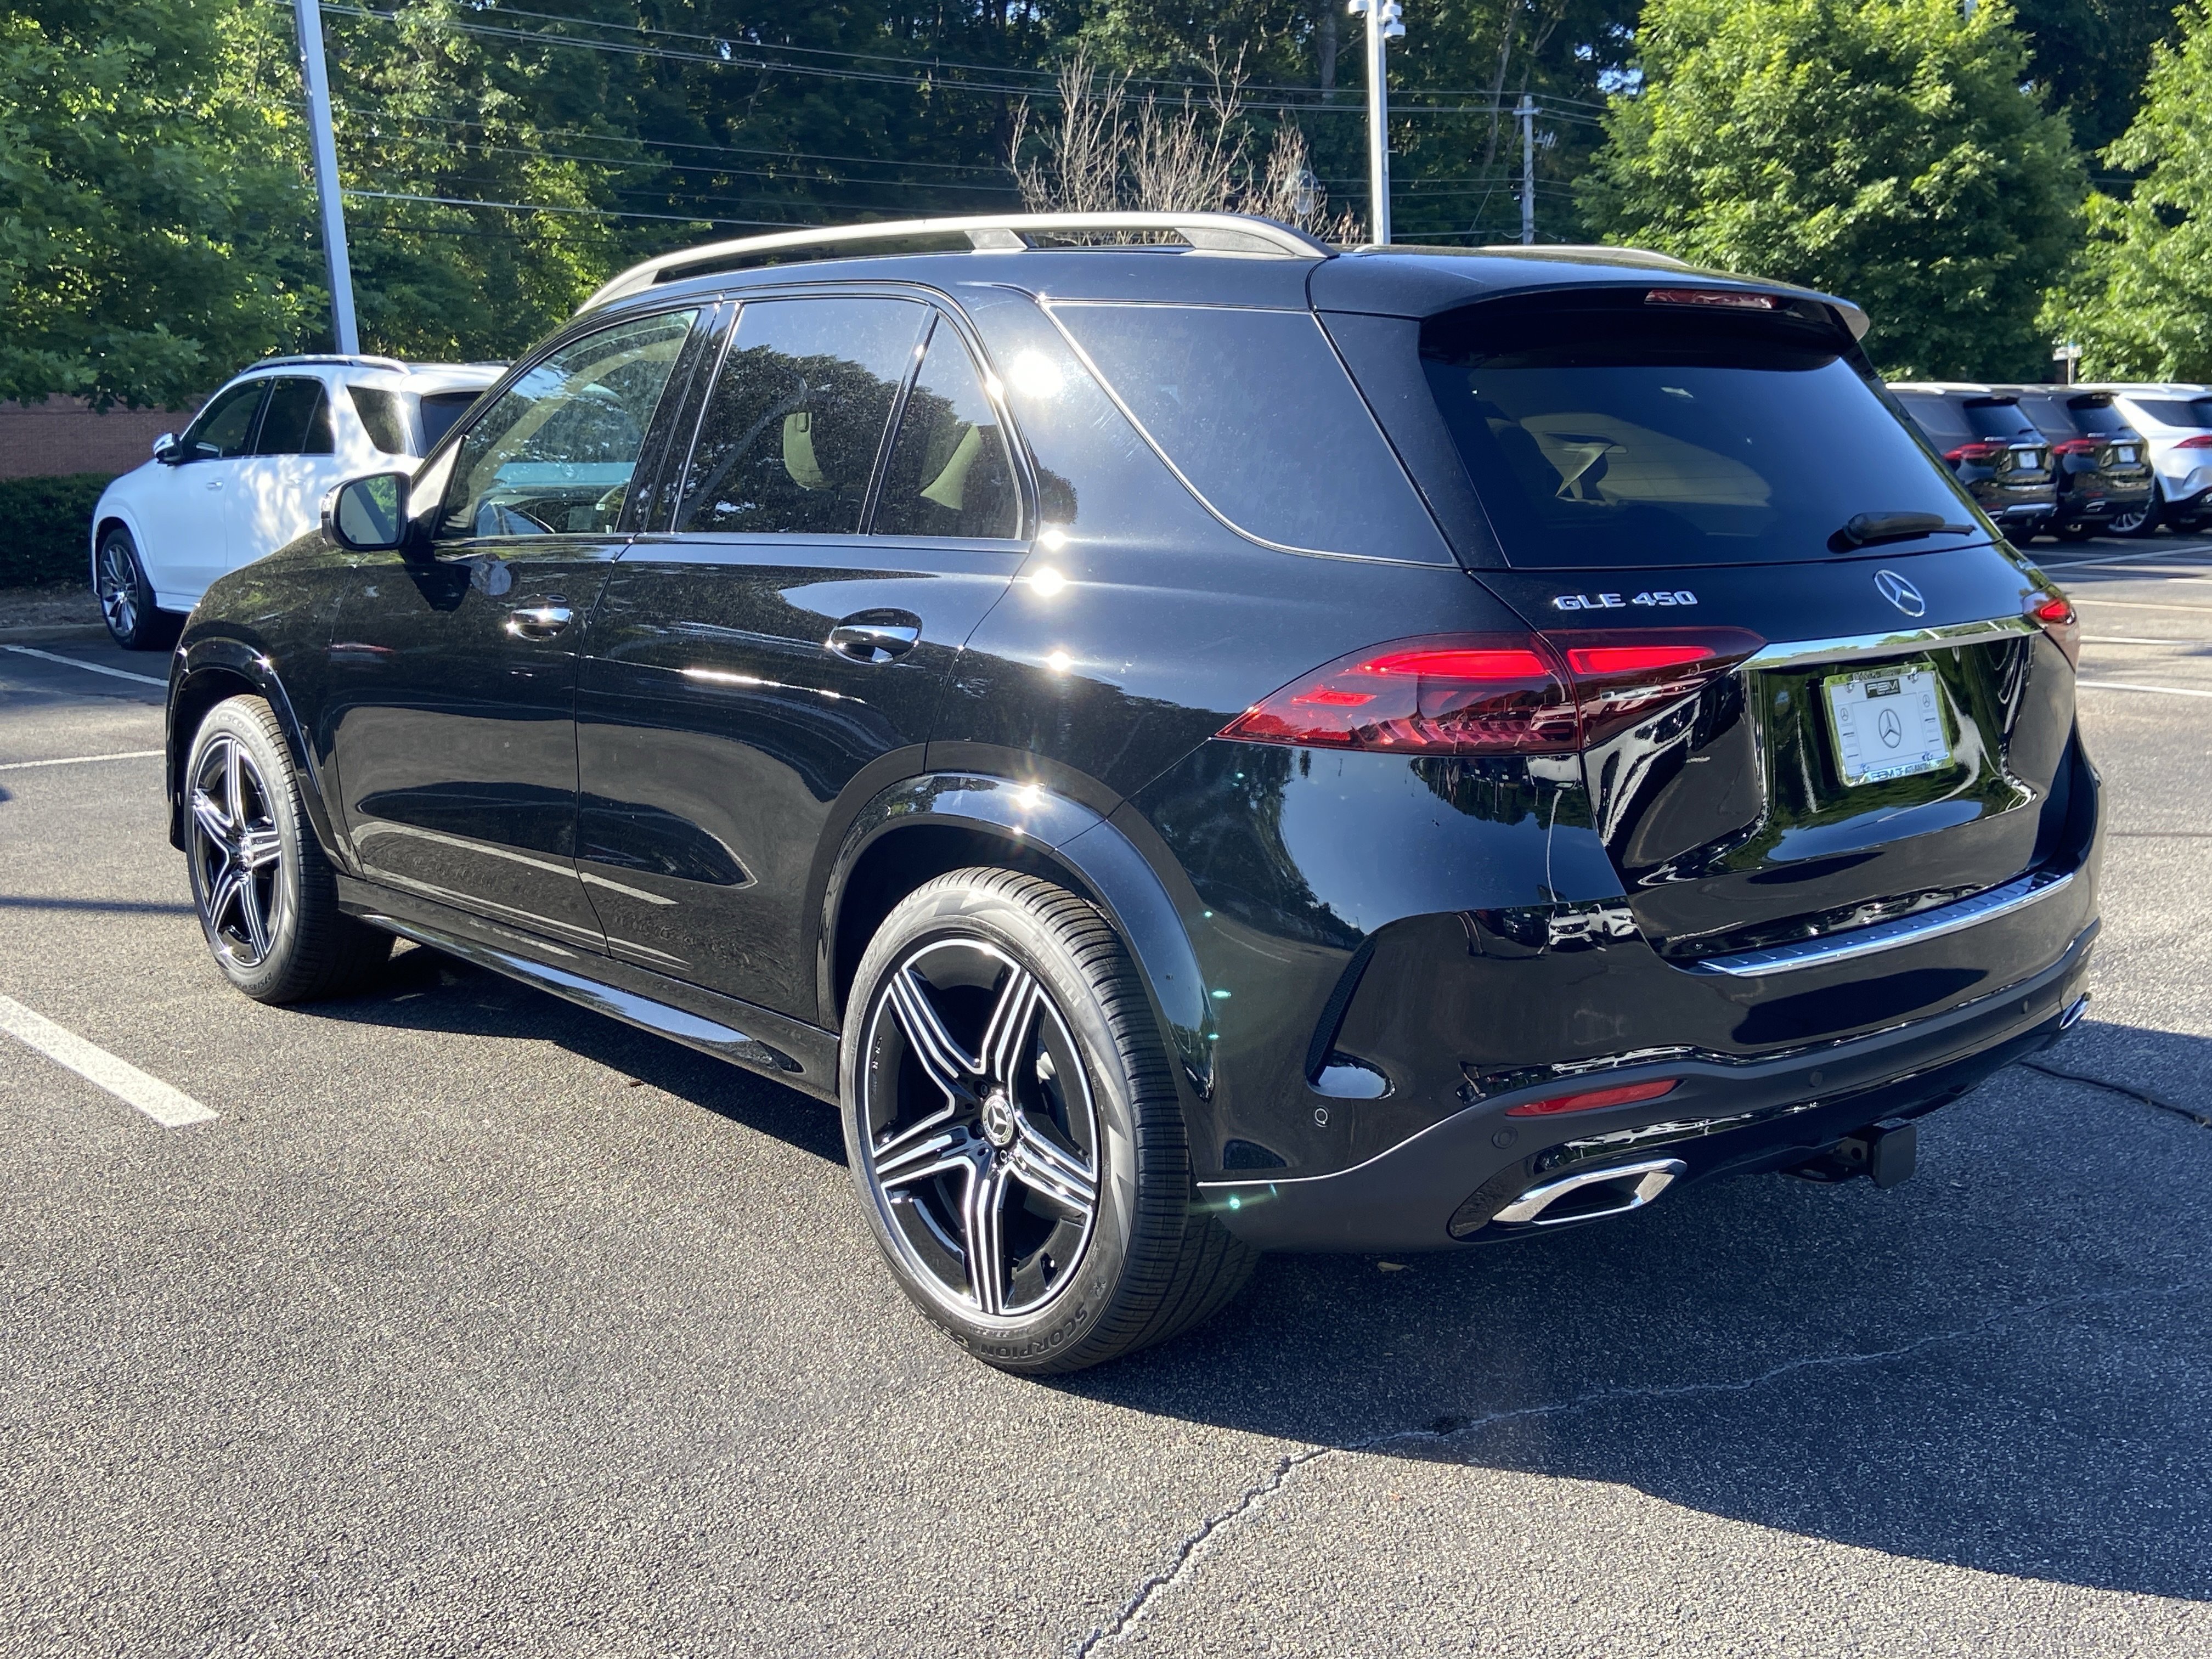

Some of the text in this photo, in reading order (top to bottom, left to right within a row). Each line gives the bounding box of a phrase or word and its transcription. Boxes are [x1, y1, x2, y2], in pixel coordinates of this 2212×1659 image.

[1553, 591, 1698, 611] GLE 450
[1029, 934, 1087, 1008] PIRELLI
[980, 1302, 1088, 1359] SCORPION
